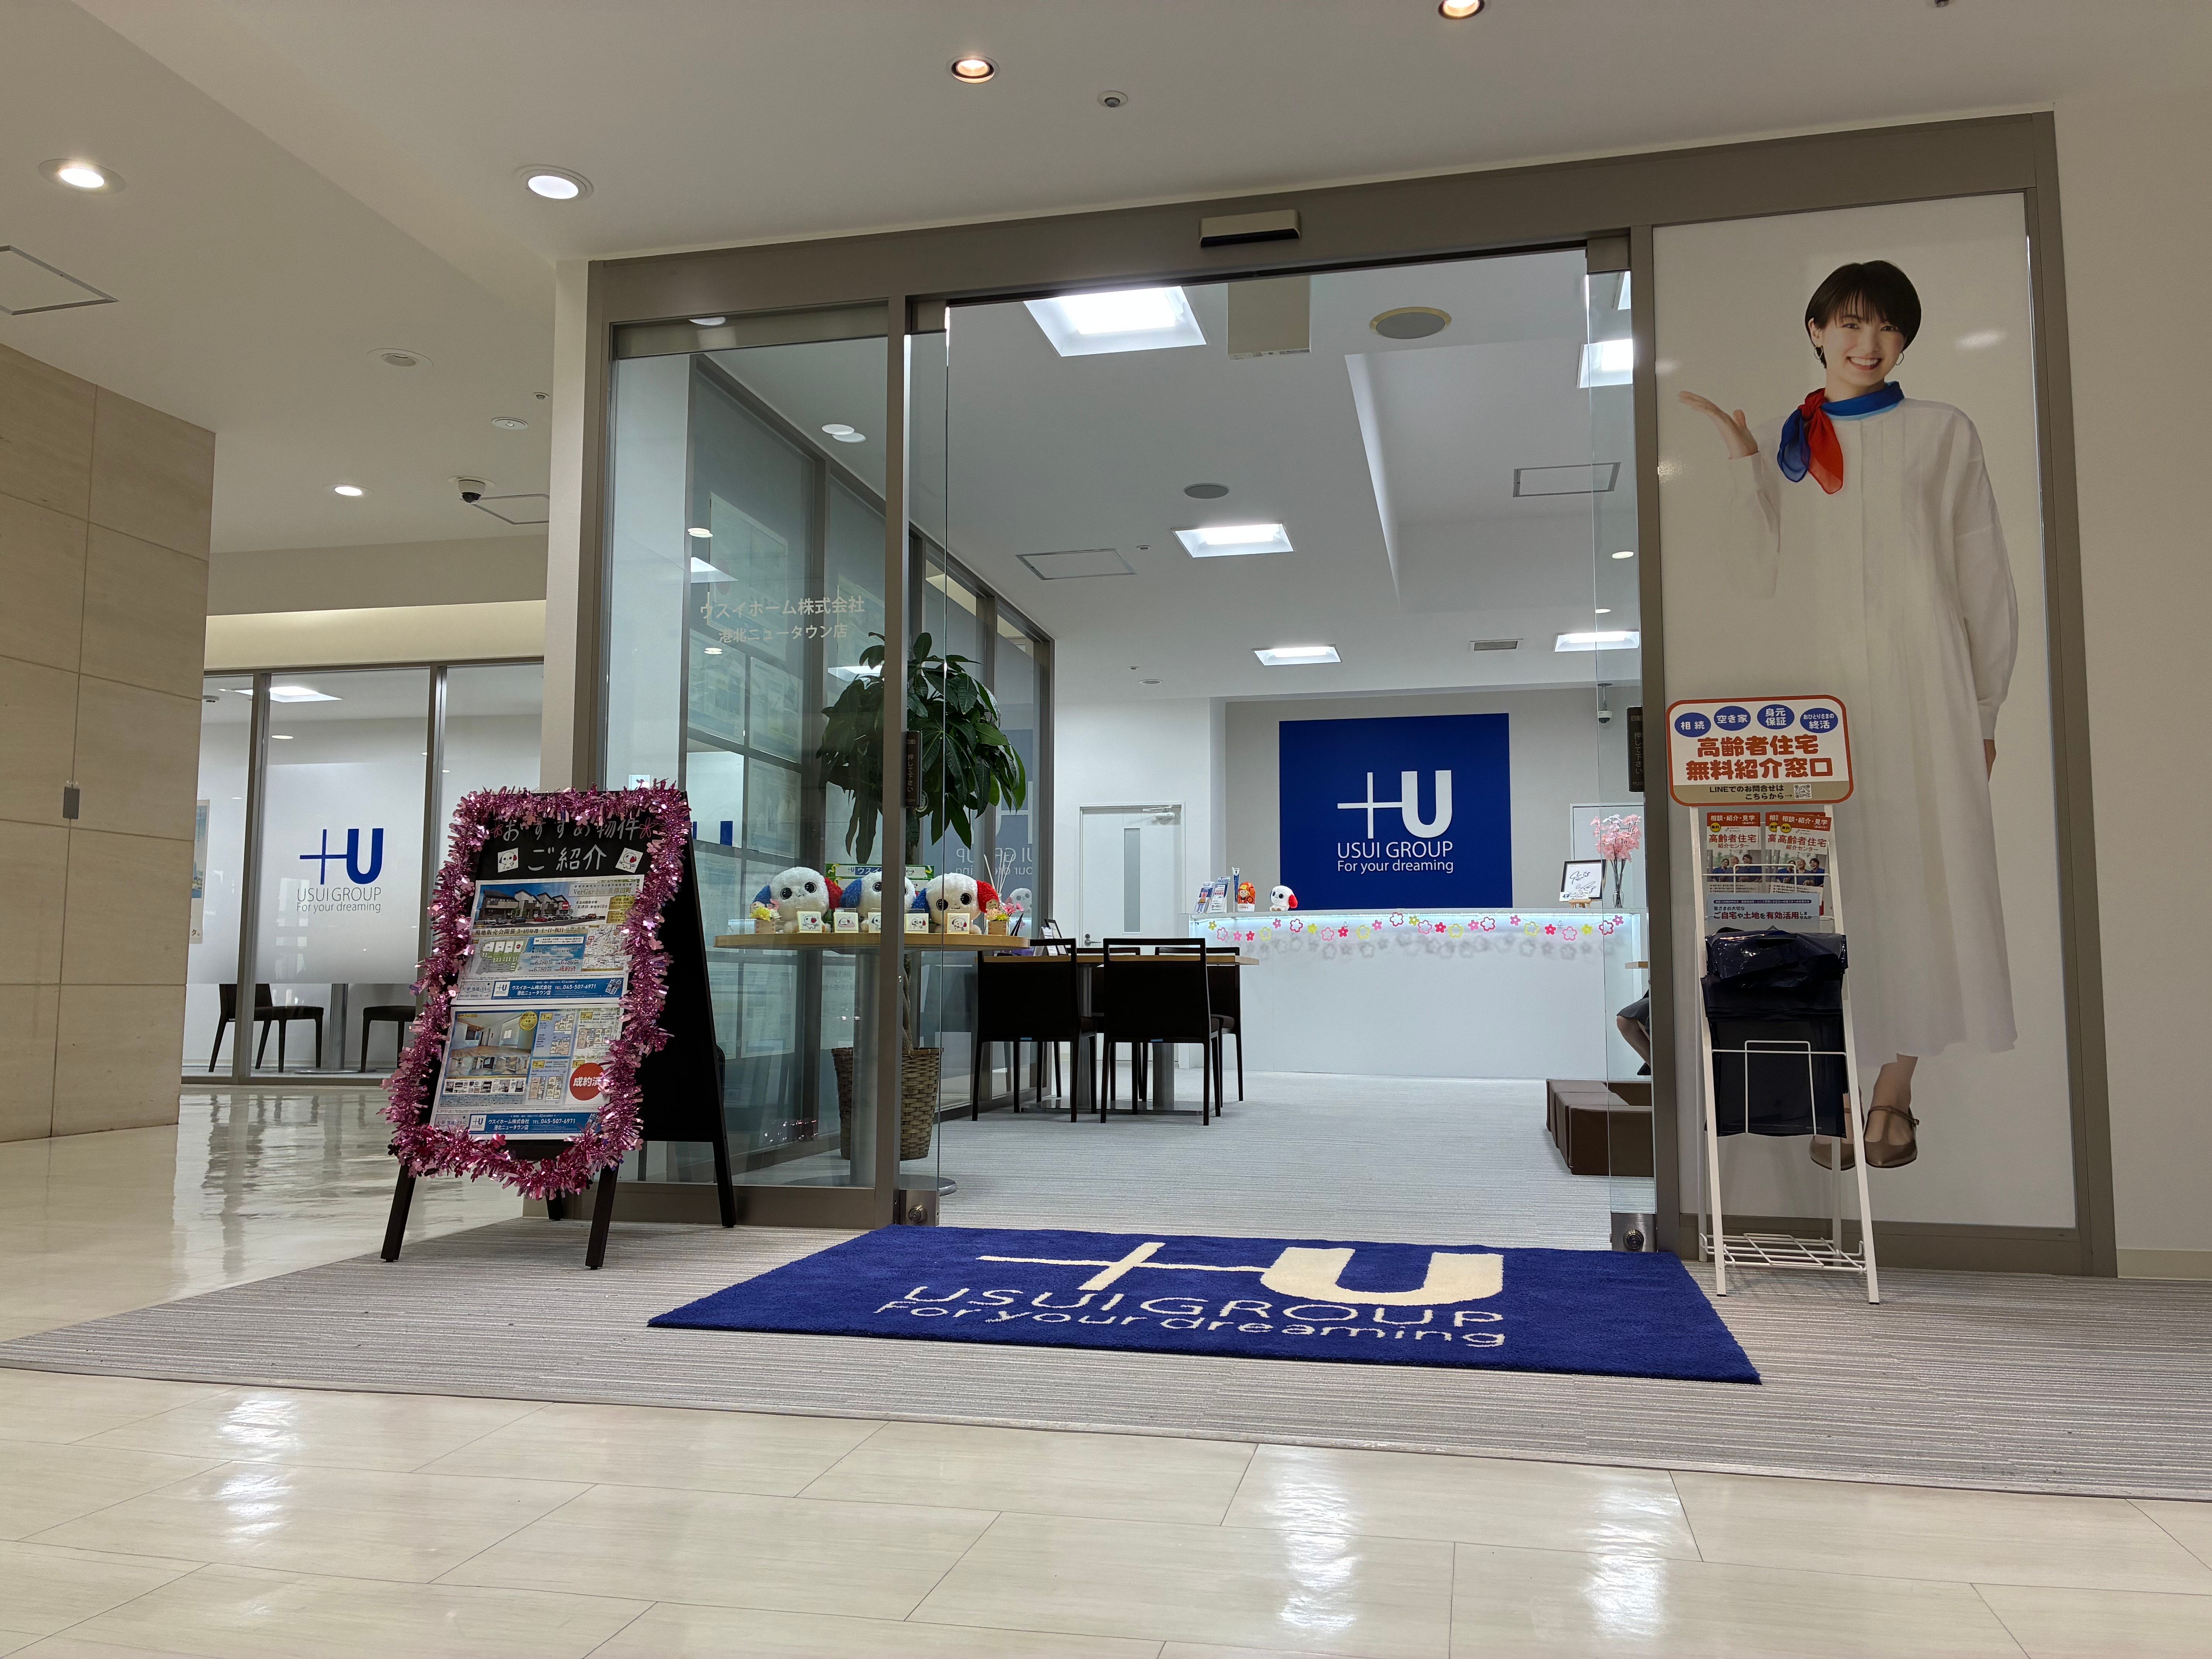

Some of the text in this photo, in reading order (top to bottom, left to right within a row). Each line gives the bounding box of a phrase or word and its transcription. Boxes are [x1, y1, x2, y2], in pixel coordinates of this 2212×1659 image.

[700, 596, 865, 619] ウスイホーム株式会社
[719, 625, 847, 644] 港北ニュータウン店
[1765, 708, 1786, 716] 身元
[1717, 714, 1748, 724] 空き家
[1765, 717, 1786, 726] 保証
[1809, 720, 1830, 729] 終活
[1681, 721, 1705, 730] 相続
[1697, 734, 1819, 757] 高齢者住宅
[1686, 758, 1833, 781] 無料紹介窓口
[1709, 785, 1784, 793] LINEでのお問合せは
[1782, 815, 1828, 825] 相談・紹介・見学
[1709, 834, 1756, 843] 高齢者住宅
[1768, 834, 1777, 843] 高
[1778, 835, 1827, 847] 高齢者住宅
[1338, 841, 1453, 859] USUI GROUP
[528, 844, 606, 871] ご紹介
[1338, 859, 1453, 874] For your dreaming
[297, 887, 381, 902] USUI GROUP
[297, 902, 381, 914] For your dreaming
[1714, 912, 1799, 920] ご自宅や土地を有効活用
[904, 1286, 1504, 1327] USUI GROUP
[873, 1301, 1506, 1348] For your dreaming
